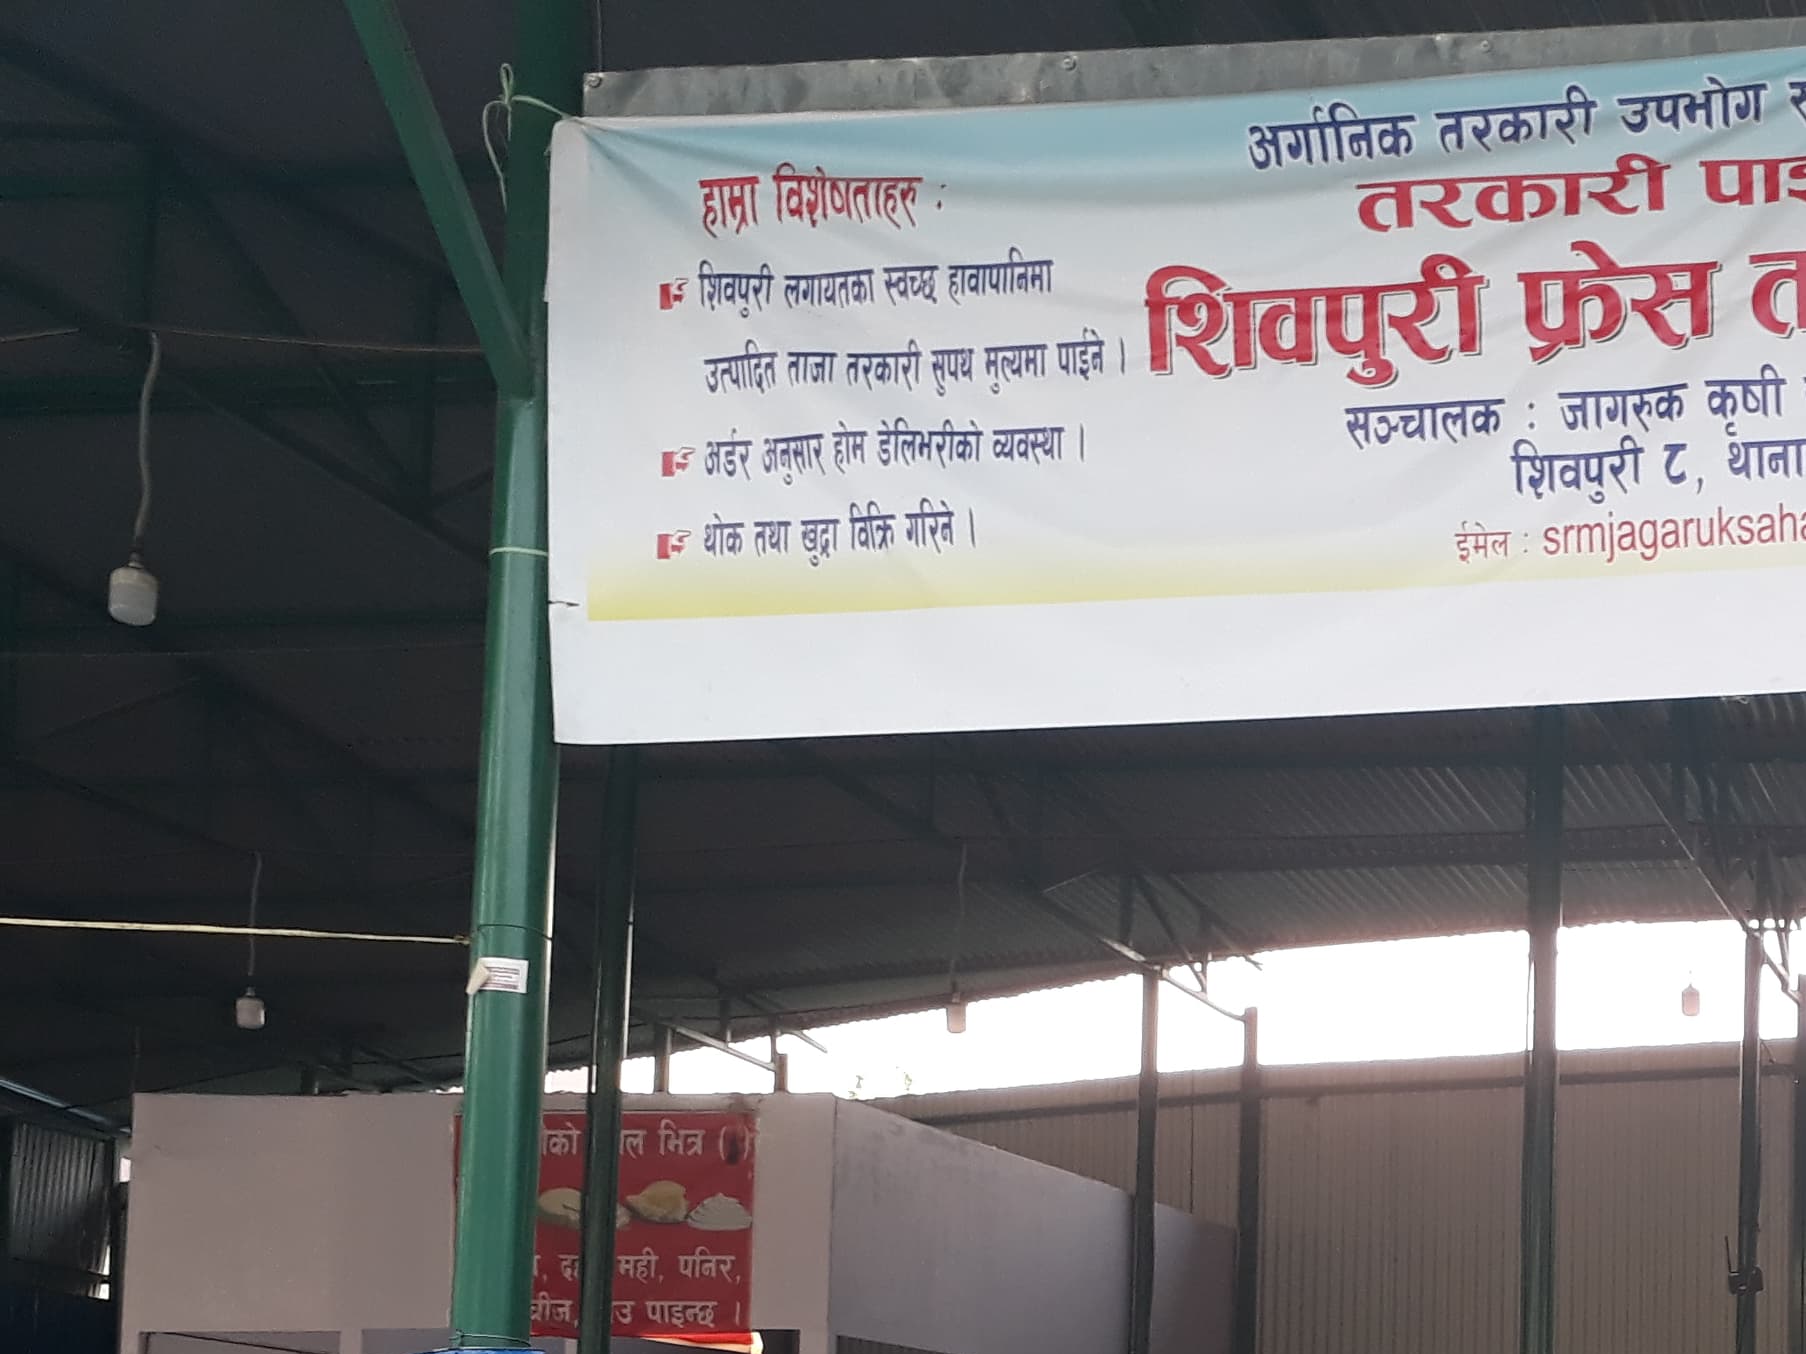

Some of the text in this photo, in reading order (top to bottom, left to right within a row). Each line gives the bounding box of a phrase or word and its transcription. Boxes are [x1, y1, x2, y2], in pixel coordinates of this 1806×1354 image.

[1436, 85, 1597, 155] तरकारी
[1617, 76, 1767, 133] उपभोग
[699, 176, 760, 238] हाम्रा
[1356, 153, 1670, 232] तरकारी
[699, 260, 774, 318] शिवपुरी
[784, 269, 875, 308] लगायतका
[948, 247, 1053, 304] हावापानिमा
[1145, 254, 1488, 386] शिवपुरी
[1517, 240, 1721, 364] फ्रेस
[704, 339, 778, 393] उत्पादित
[787, 352, 837, 386] ताजा
[847, 339, 922, 391] तरकारी
[931, 348, 974, 396] सुपथ
[985, 344, 1047, 394] मुल्यमा
[1345, 399, 1505, 449] सञ्चालक
[1558, 383, 1688, 432] जागरुक
[1704, 364, 1787, 437] कृषी
[704, 428, 752, 480] अर्डर
[763, 433, 825, 485] अनुसार
[832, 421, 867, 474] होम
[877, 417, 983, 470] डेलिभरीको
[993, 427, 1064, 464] व्यवस्था
[1511, 435, 1644, 504] शिवपुरी
[704, 513, 744, 556] थोक
[754, 520, 791, 555] तथा
[801, 518, 839, 566] खुद्रा
[849, 501, 895, 552] विक्रि
[905, 498, 954, 553] गरिने
[1455, 521, 1512, 563] ईमेल
[657, 1119, 706, 1156] भित्र
[645, 1301, 718, 1328] पाइन्छ
